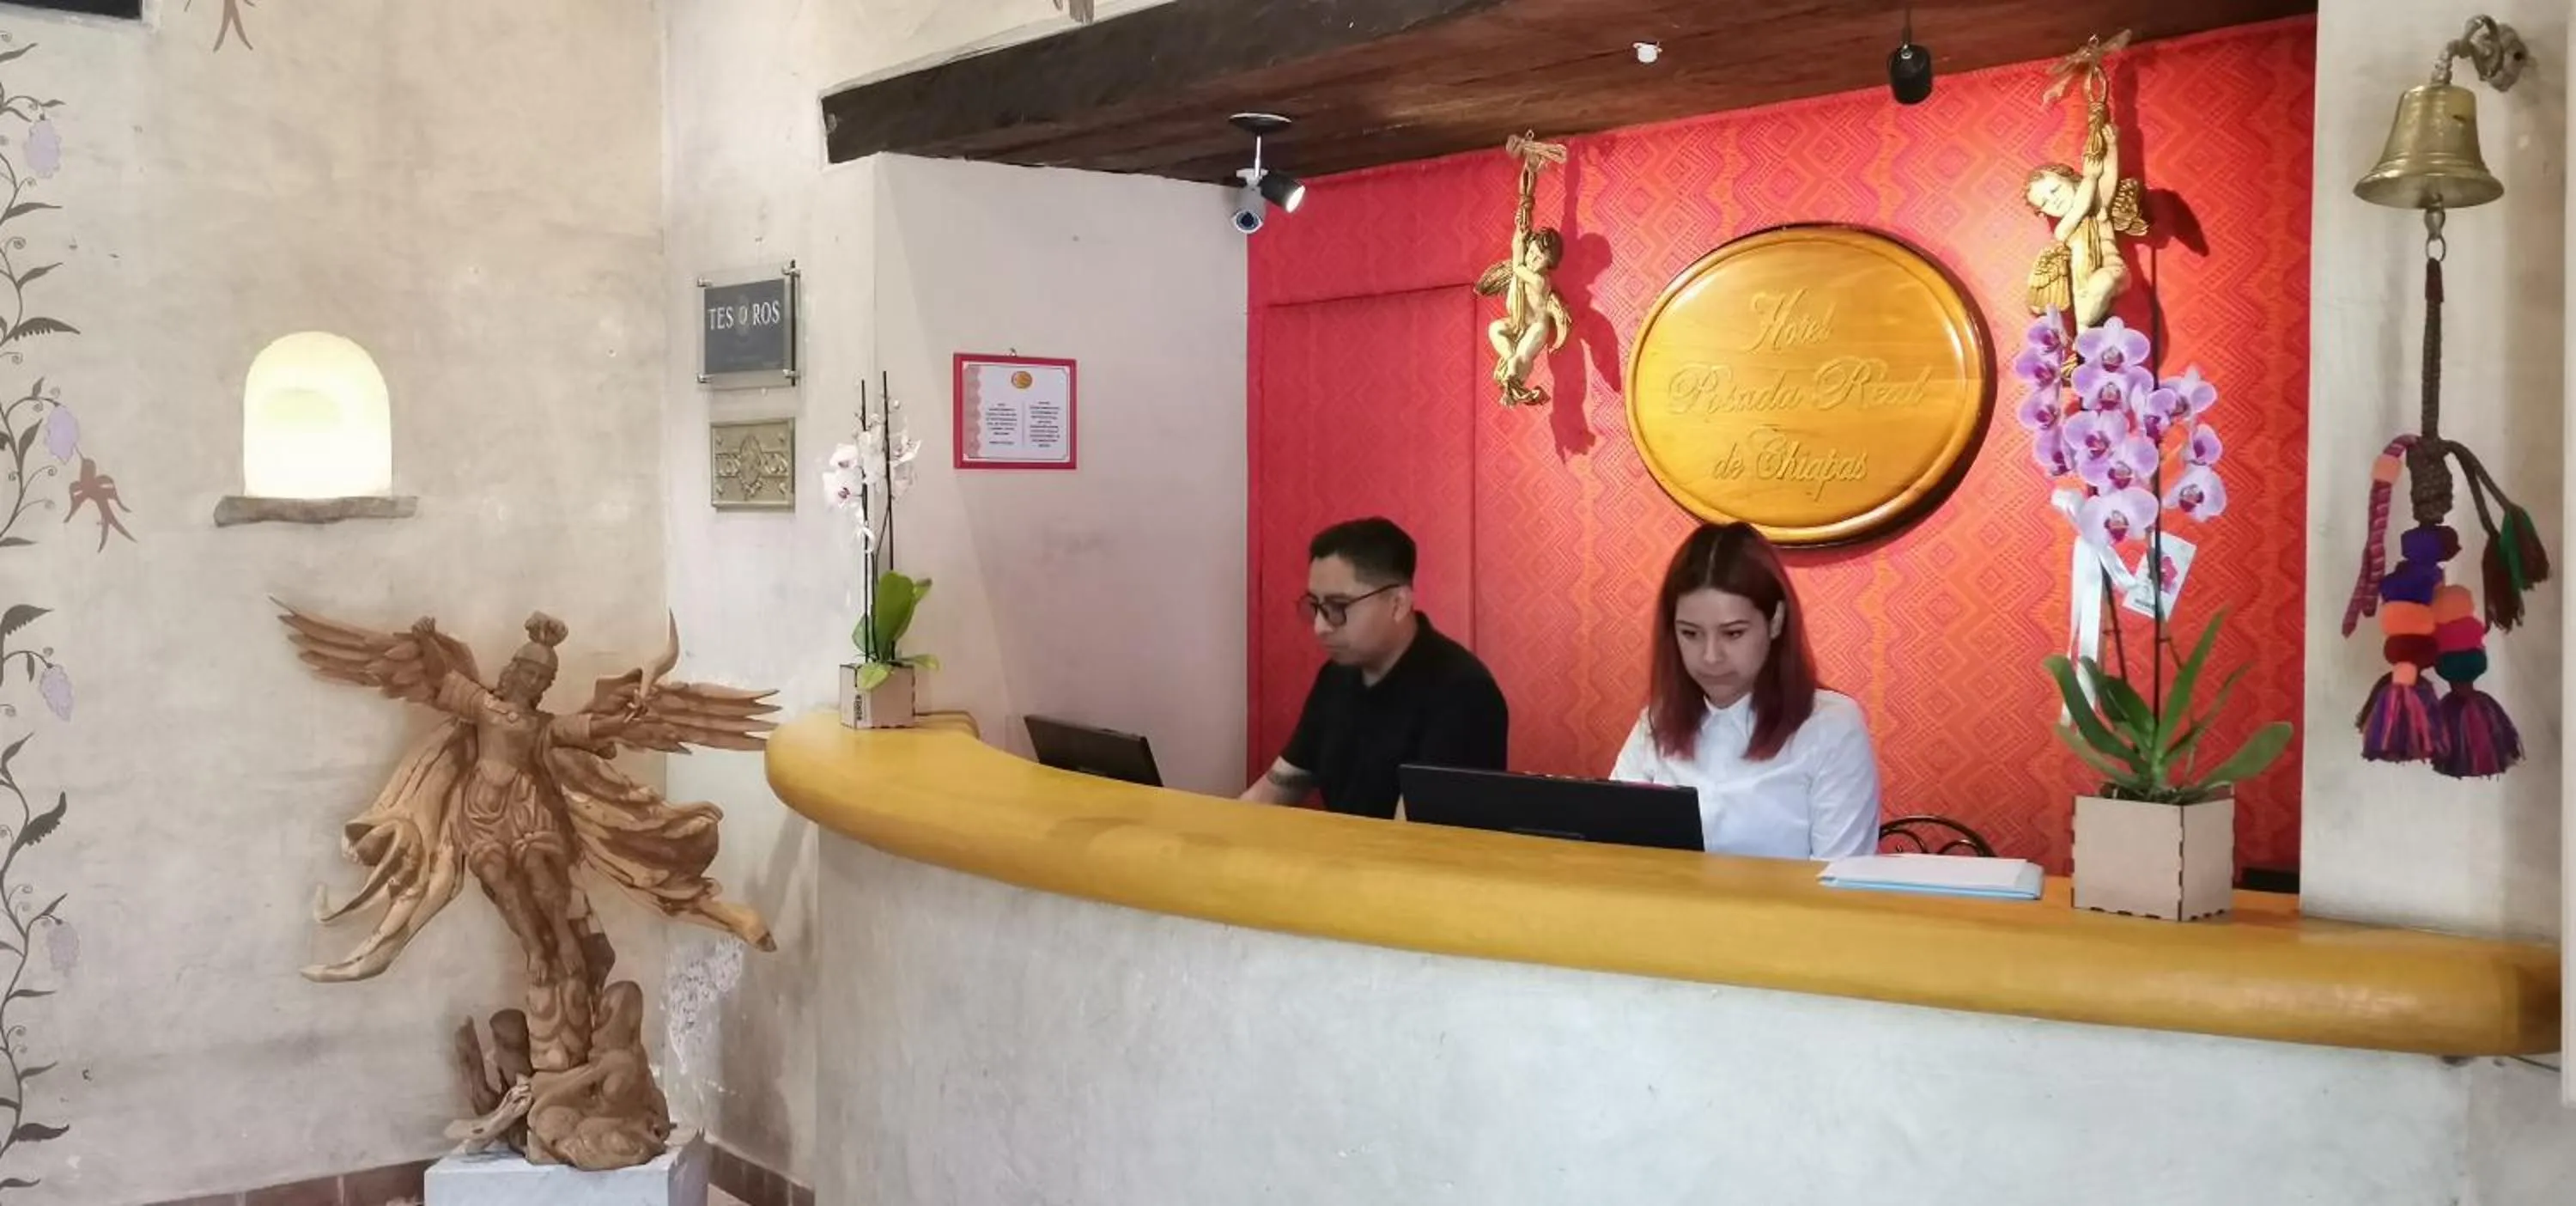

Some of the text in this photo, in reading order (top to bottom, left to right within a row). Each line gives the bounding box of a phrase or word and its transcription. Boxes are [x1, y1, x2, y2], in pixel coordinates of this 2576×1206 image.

[1746, 288, 1836, 354] Hotel
[1668, 355, 1932, 414] Posada Real
[1712, 427, 1868, 503] de Chiapas
